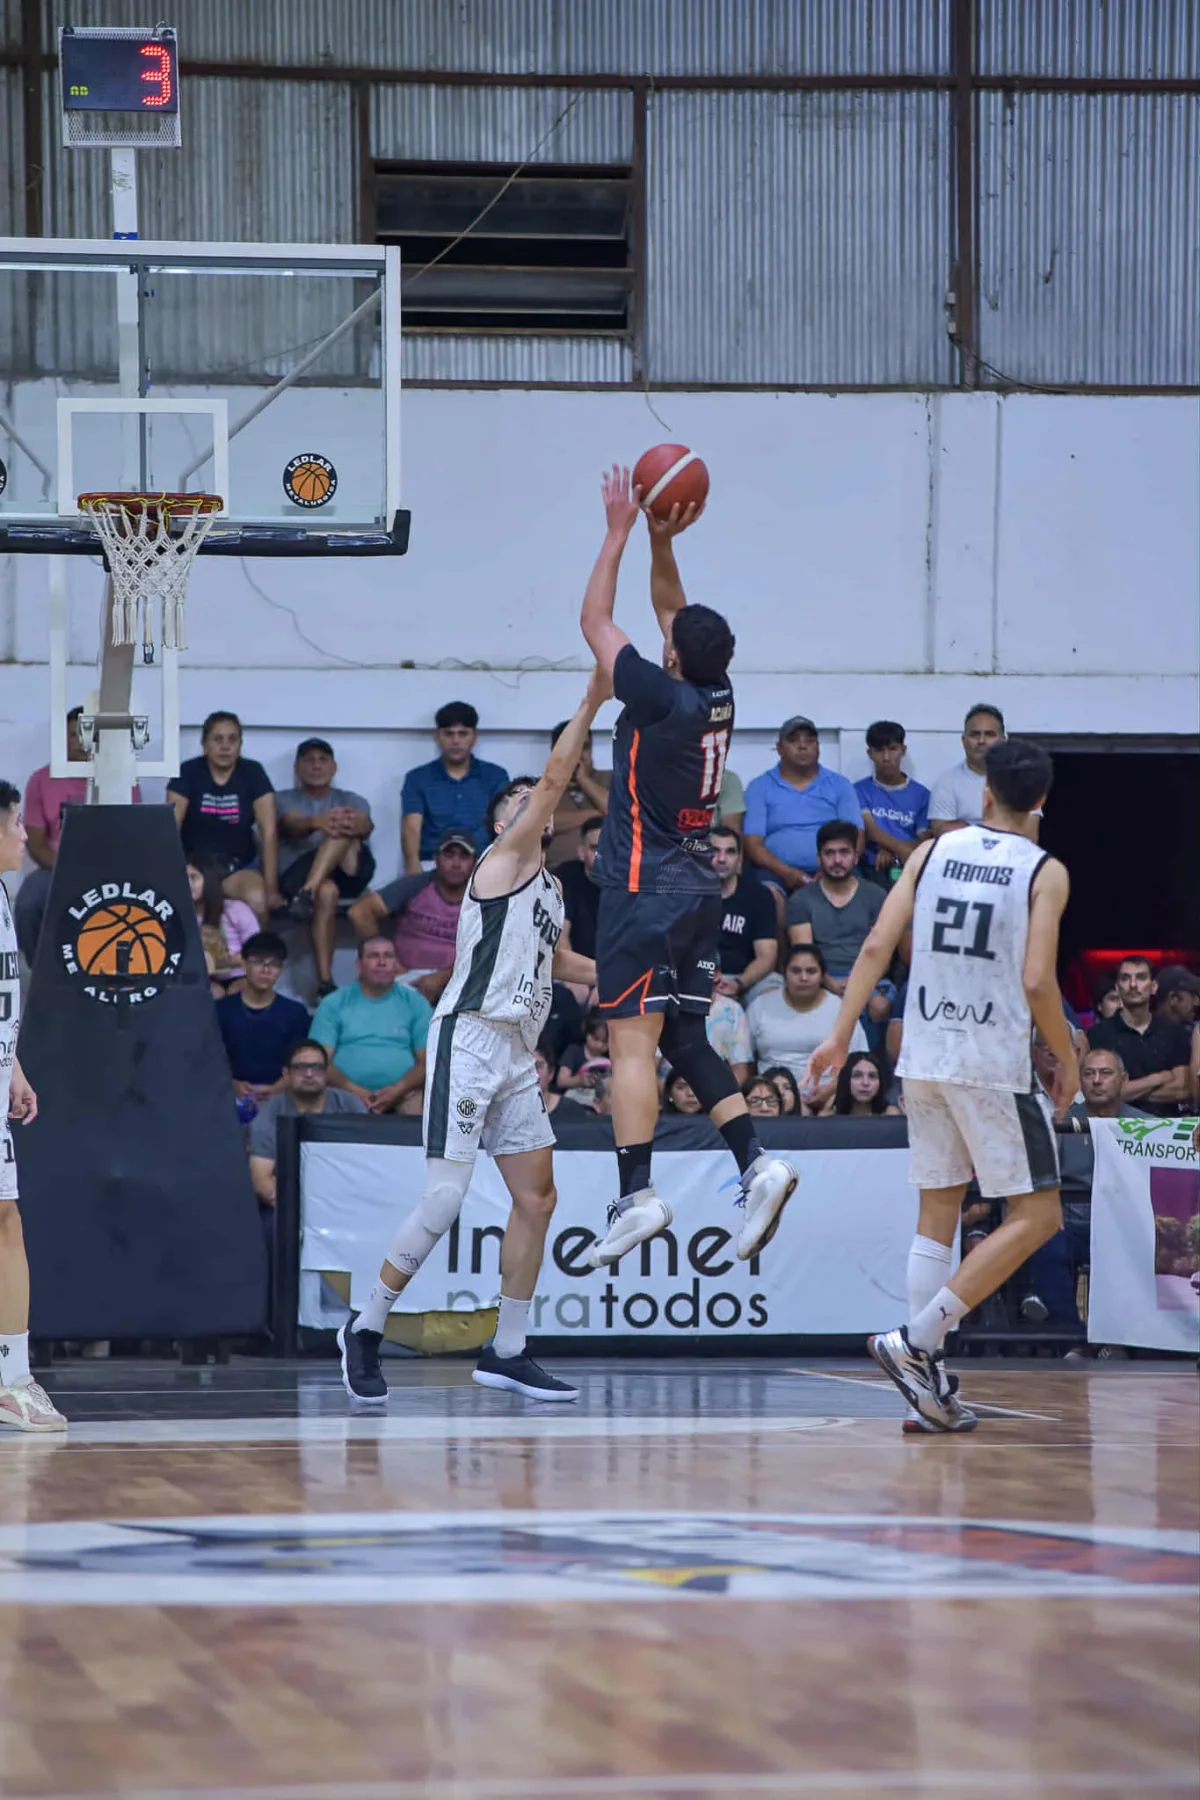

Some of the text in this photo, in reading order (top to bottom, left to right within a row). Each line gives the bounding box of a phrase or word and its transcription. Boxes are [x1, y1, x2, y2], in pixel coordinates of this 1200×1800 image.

[140, 45, 170, 105] 3
[288, 455, 332, 472] LEDLAR
[700, 728, 728, 799] 11
[943, 859, 1014, 887] RAMOS
[68, 882, 174, 921] LEDLAR
[722, 914, 746, 934] AIR
[932, 897, 996, 961] 21
